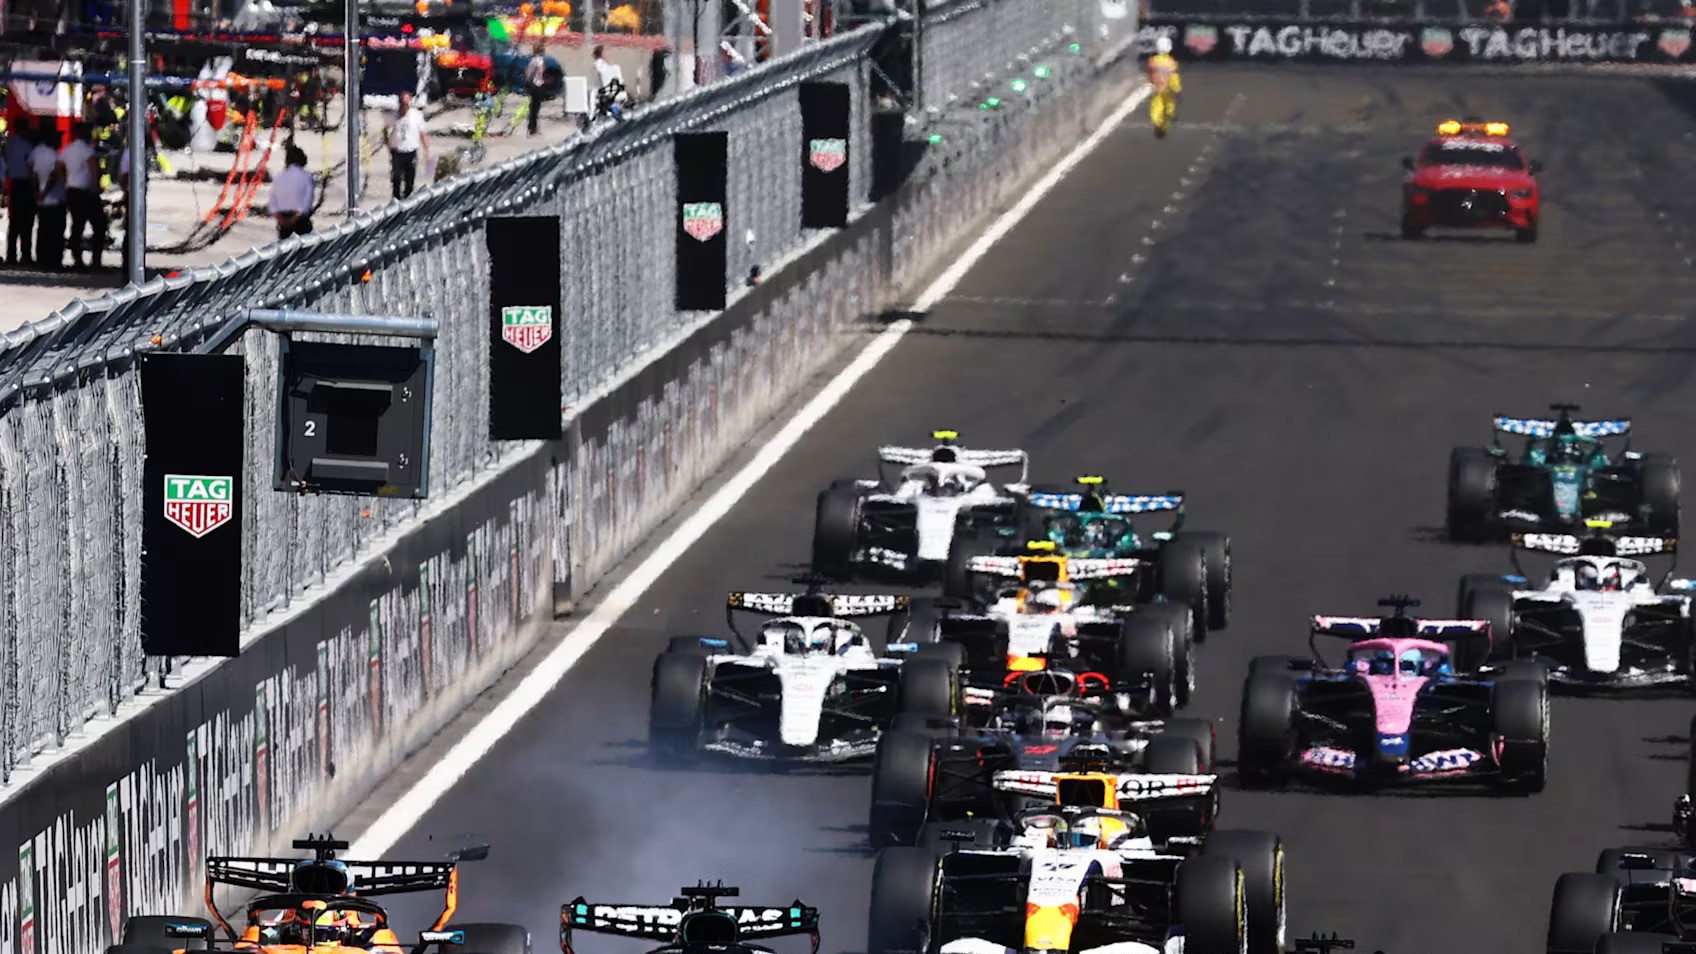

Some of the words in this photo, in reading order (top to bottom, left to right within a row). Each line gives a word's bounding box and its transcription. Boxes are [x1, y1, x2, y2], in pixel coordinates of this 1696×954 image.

[510, 308, 547, 323] TAG
[504, 326, 550, 351] HEUER
[304, 421, 316, 437] 2
[171, 479, 226, 499] TAG
[167, 502, 230, 533] HEUER
